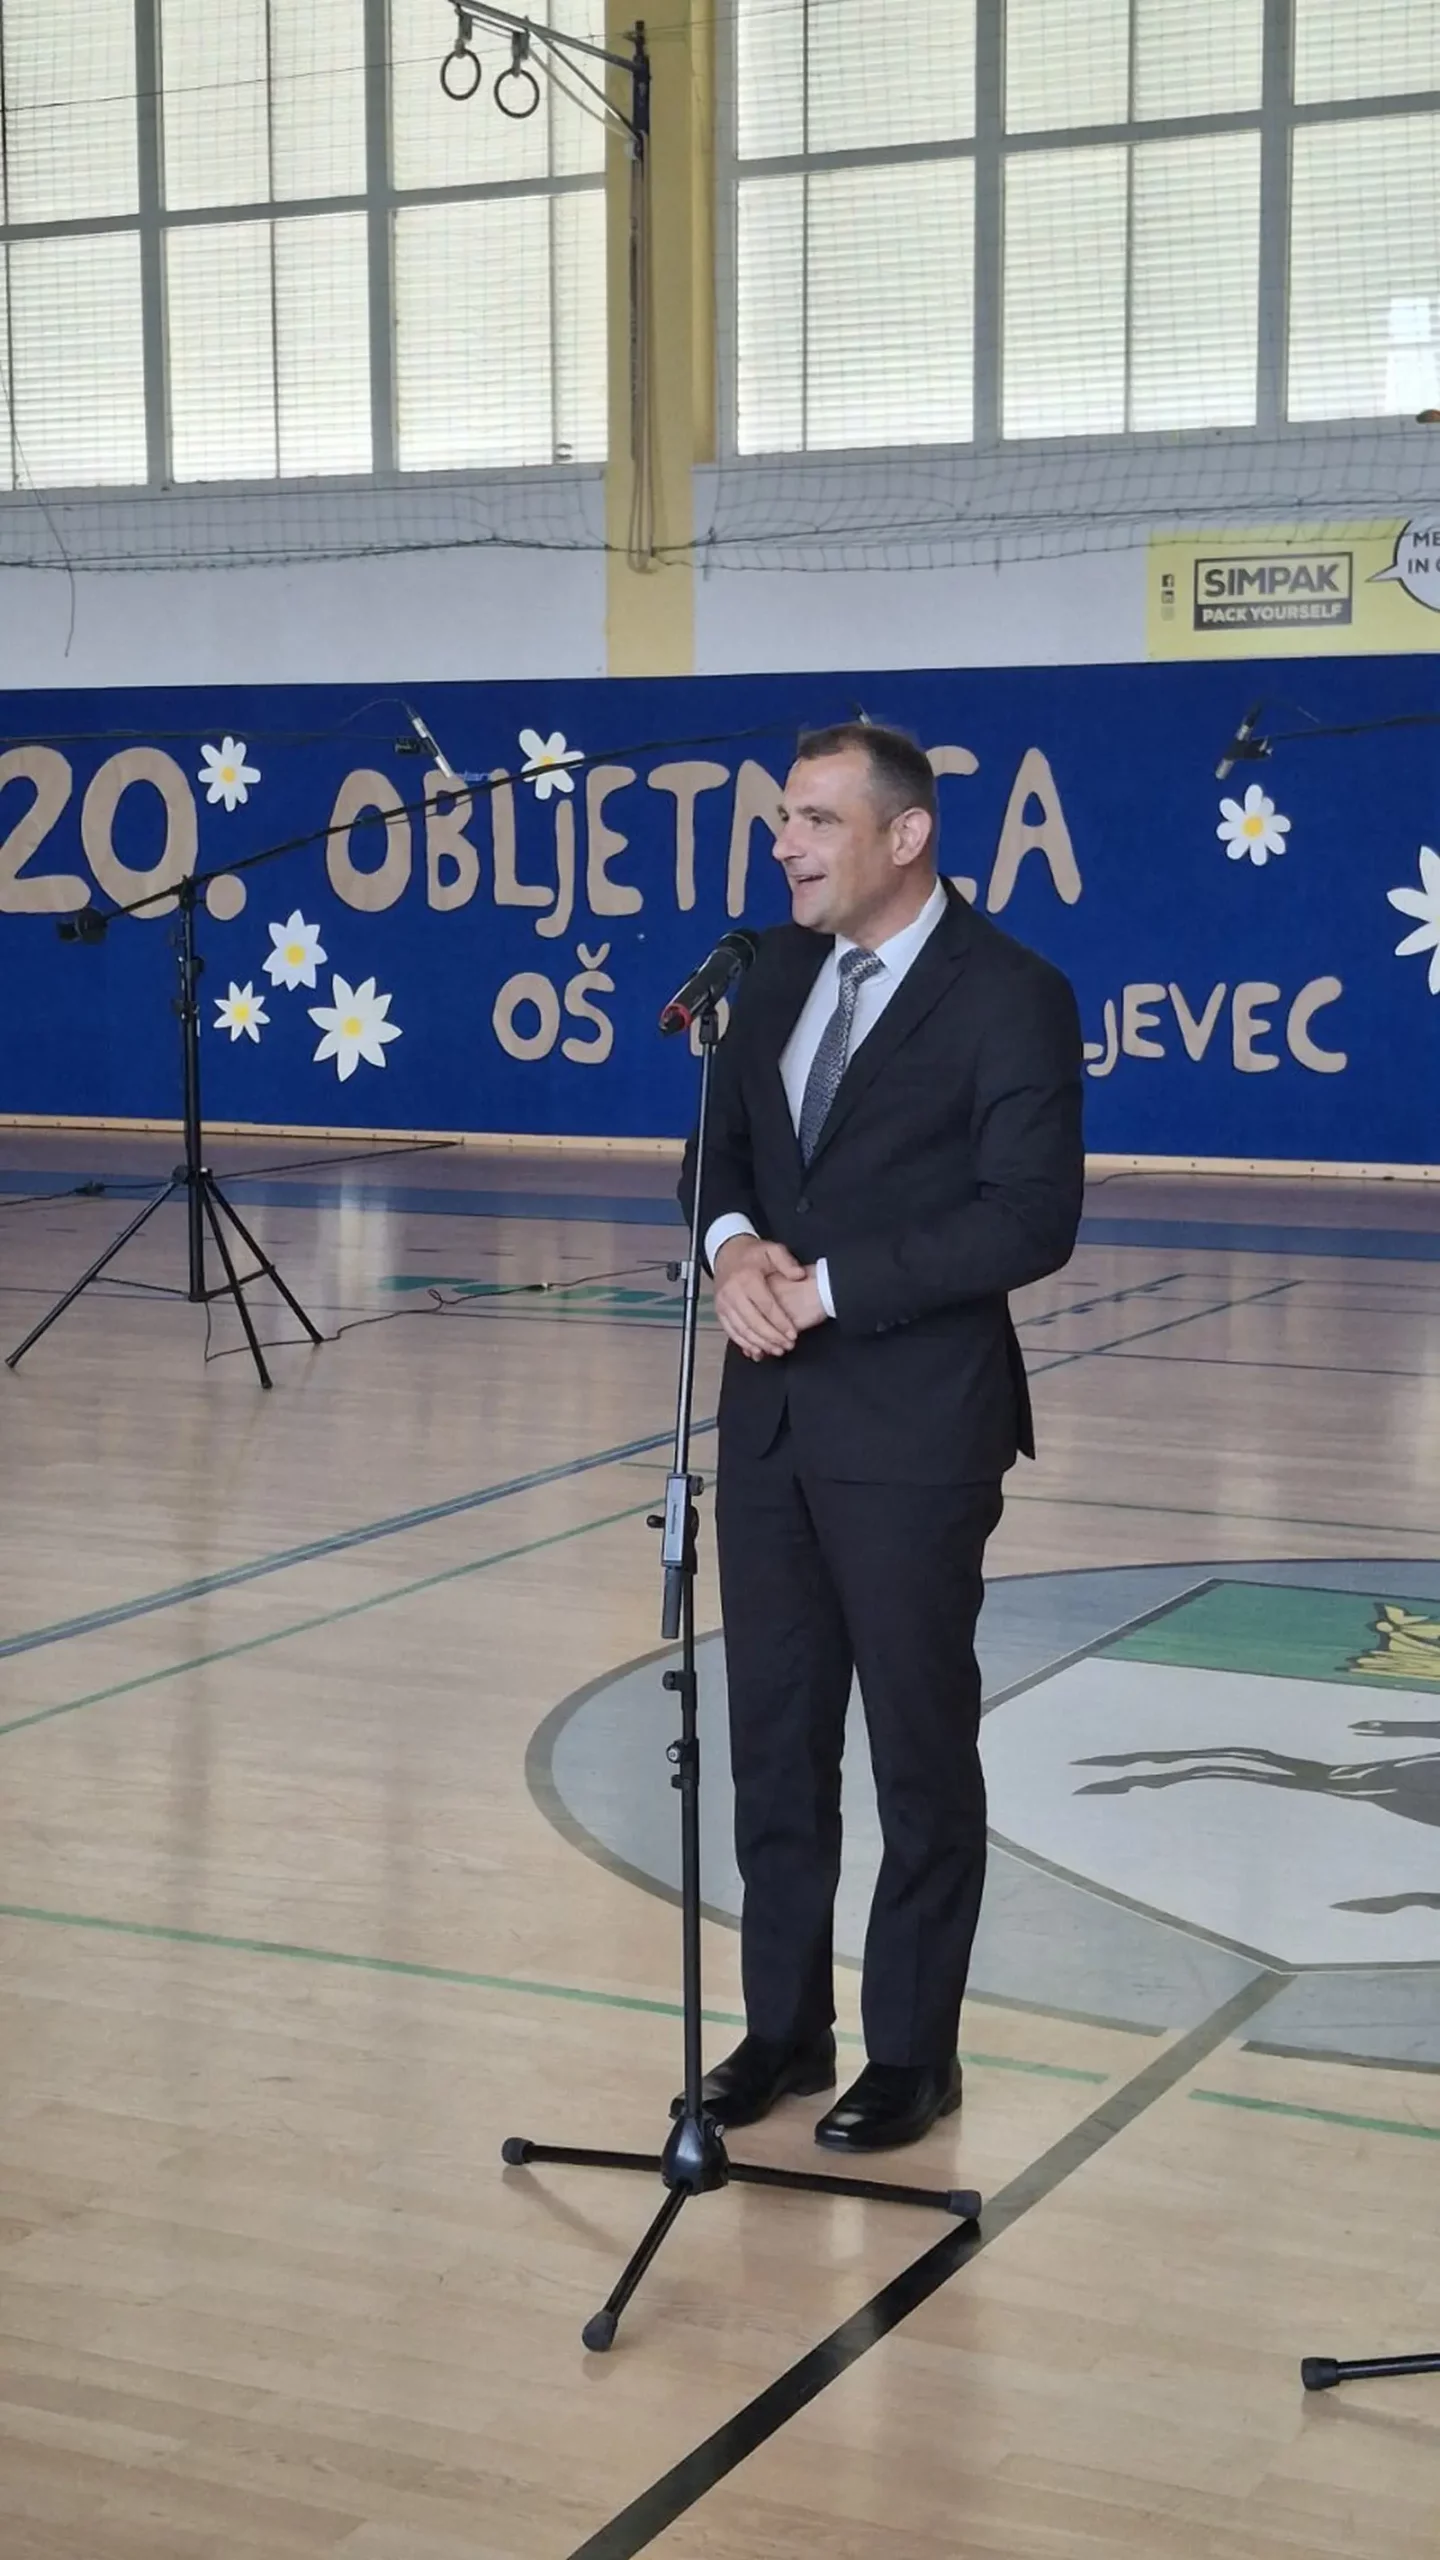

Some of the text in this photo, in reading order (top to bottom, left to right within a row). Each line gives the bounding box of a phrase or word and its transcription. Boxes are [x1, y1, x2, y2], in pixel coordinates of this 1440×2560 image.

[1204, 563, 1340, 598] SIMPAK
[1408, 557, 1429, 575] IN
[1202, 602, 1343, 624] PACK YOURSELF
[0, 745, 248, 921] 20.
[492, 942, 614, 1064] OŠ
